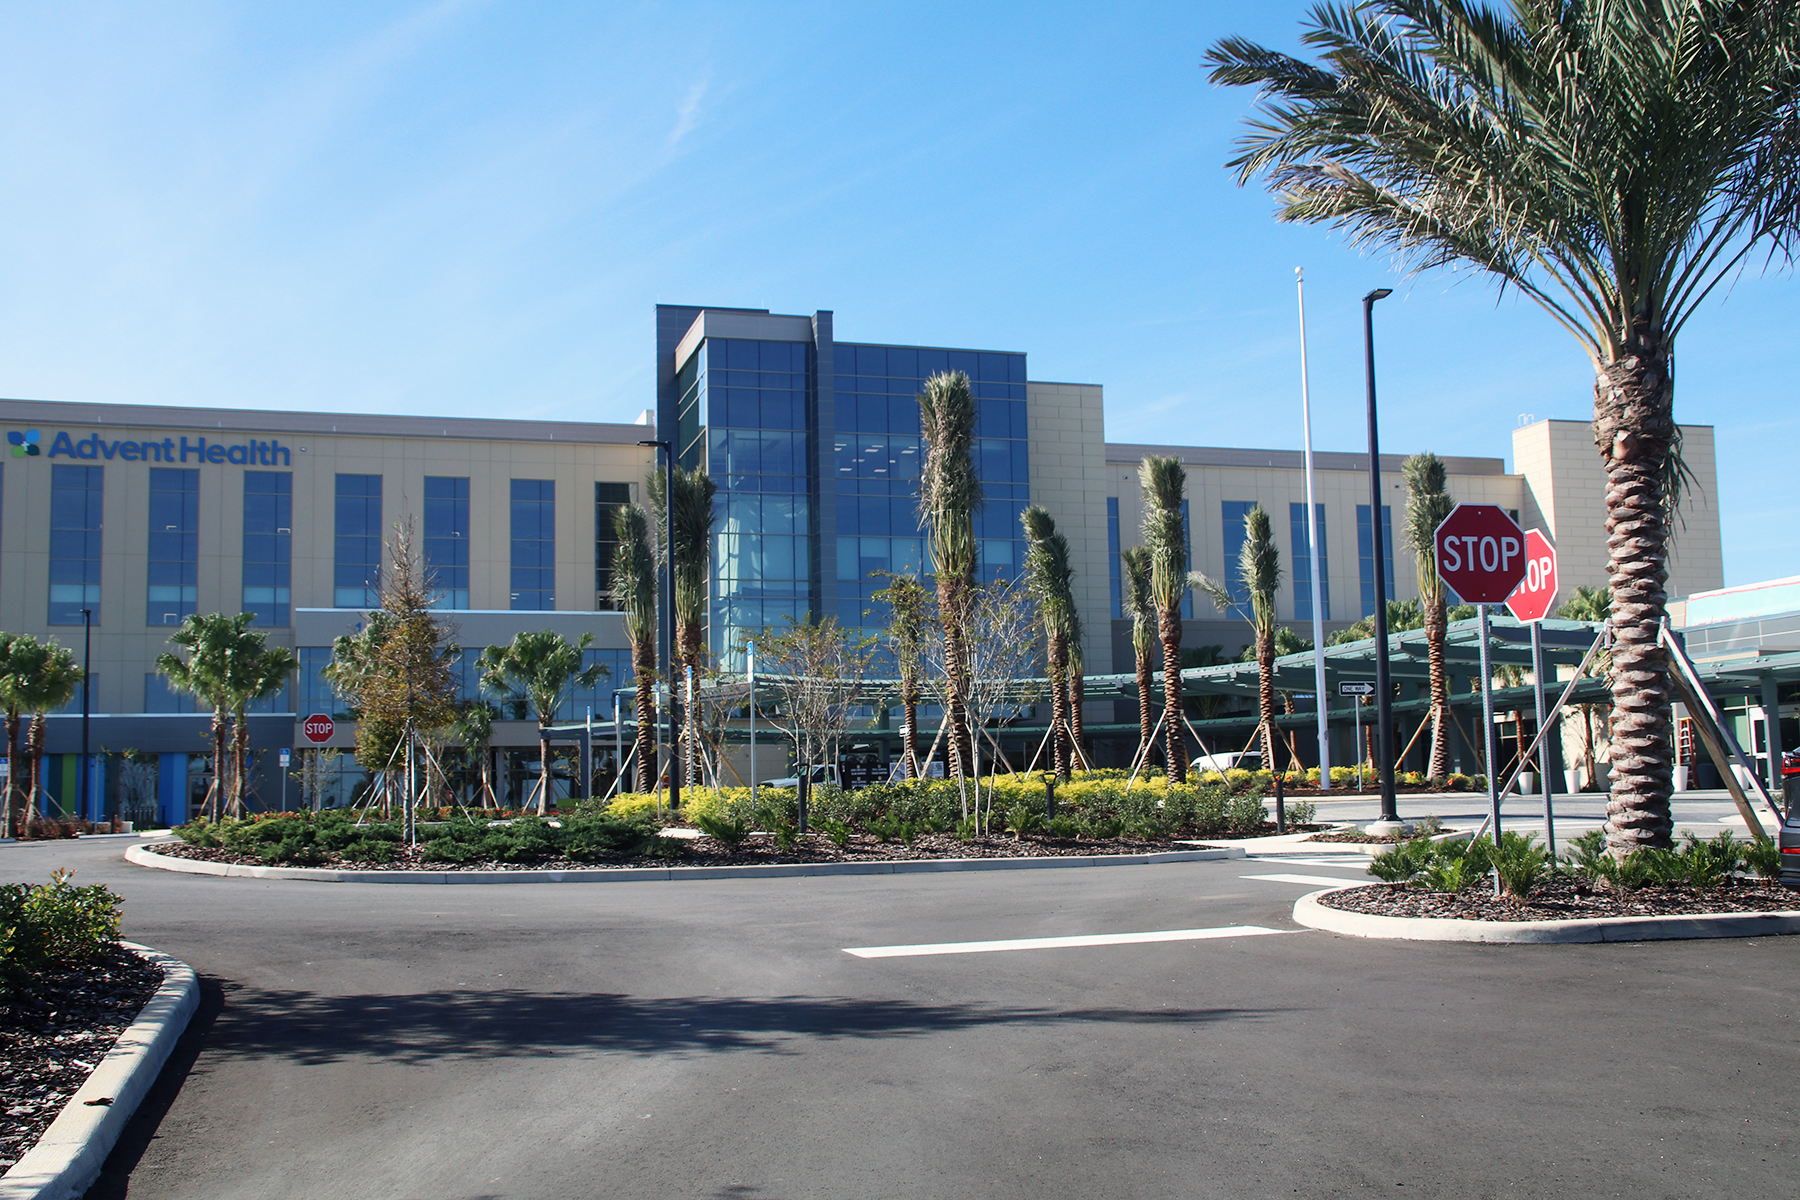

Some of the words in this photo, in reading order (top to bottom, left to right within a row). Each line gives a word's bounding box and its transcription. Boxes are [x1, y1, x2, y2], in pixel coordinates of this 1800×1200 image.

[48, 431, 291, 466] AdventHealth
[1443, 535, 1520, 572] STOP
[1511, 556, 1553, 597] OP
[306, 723, 333, 734] STOP
